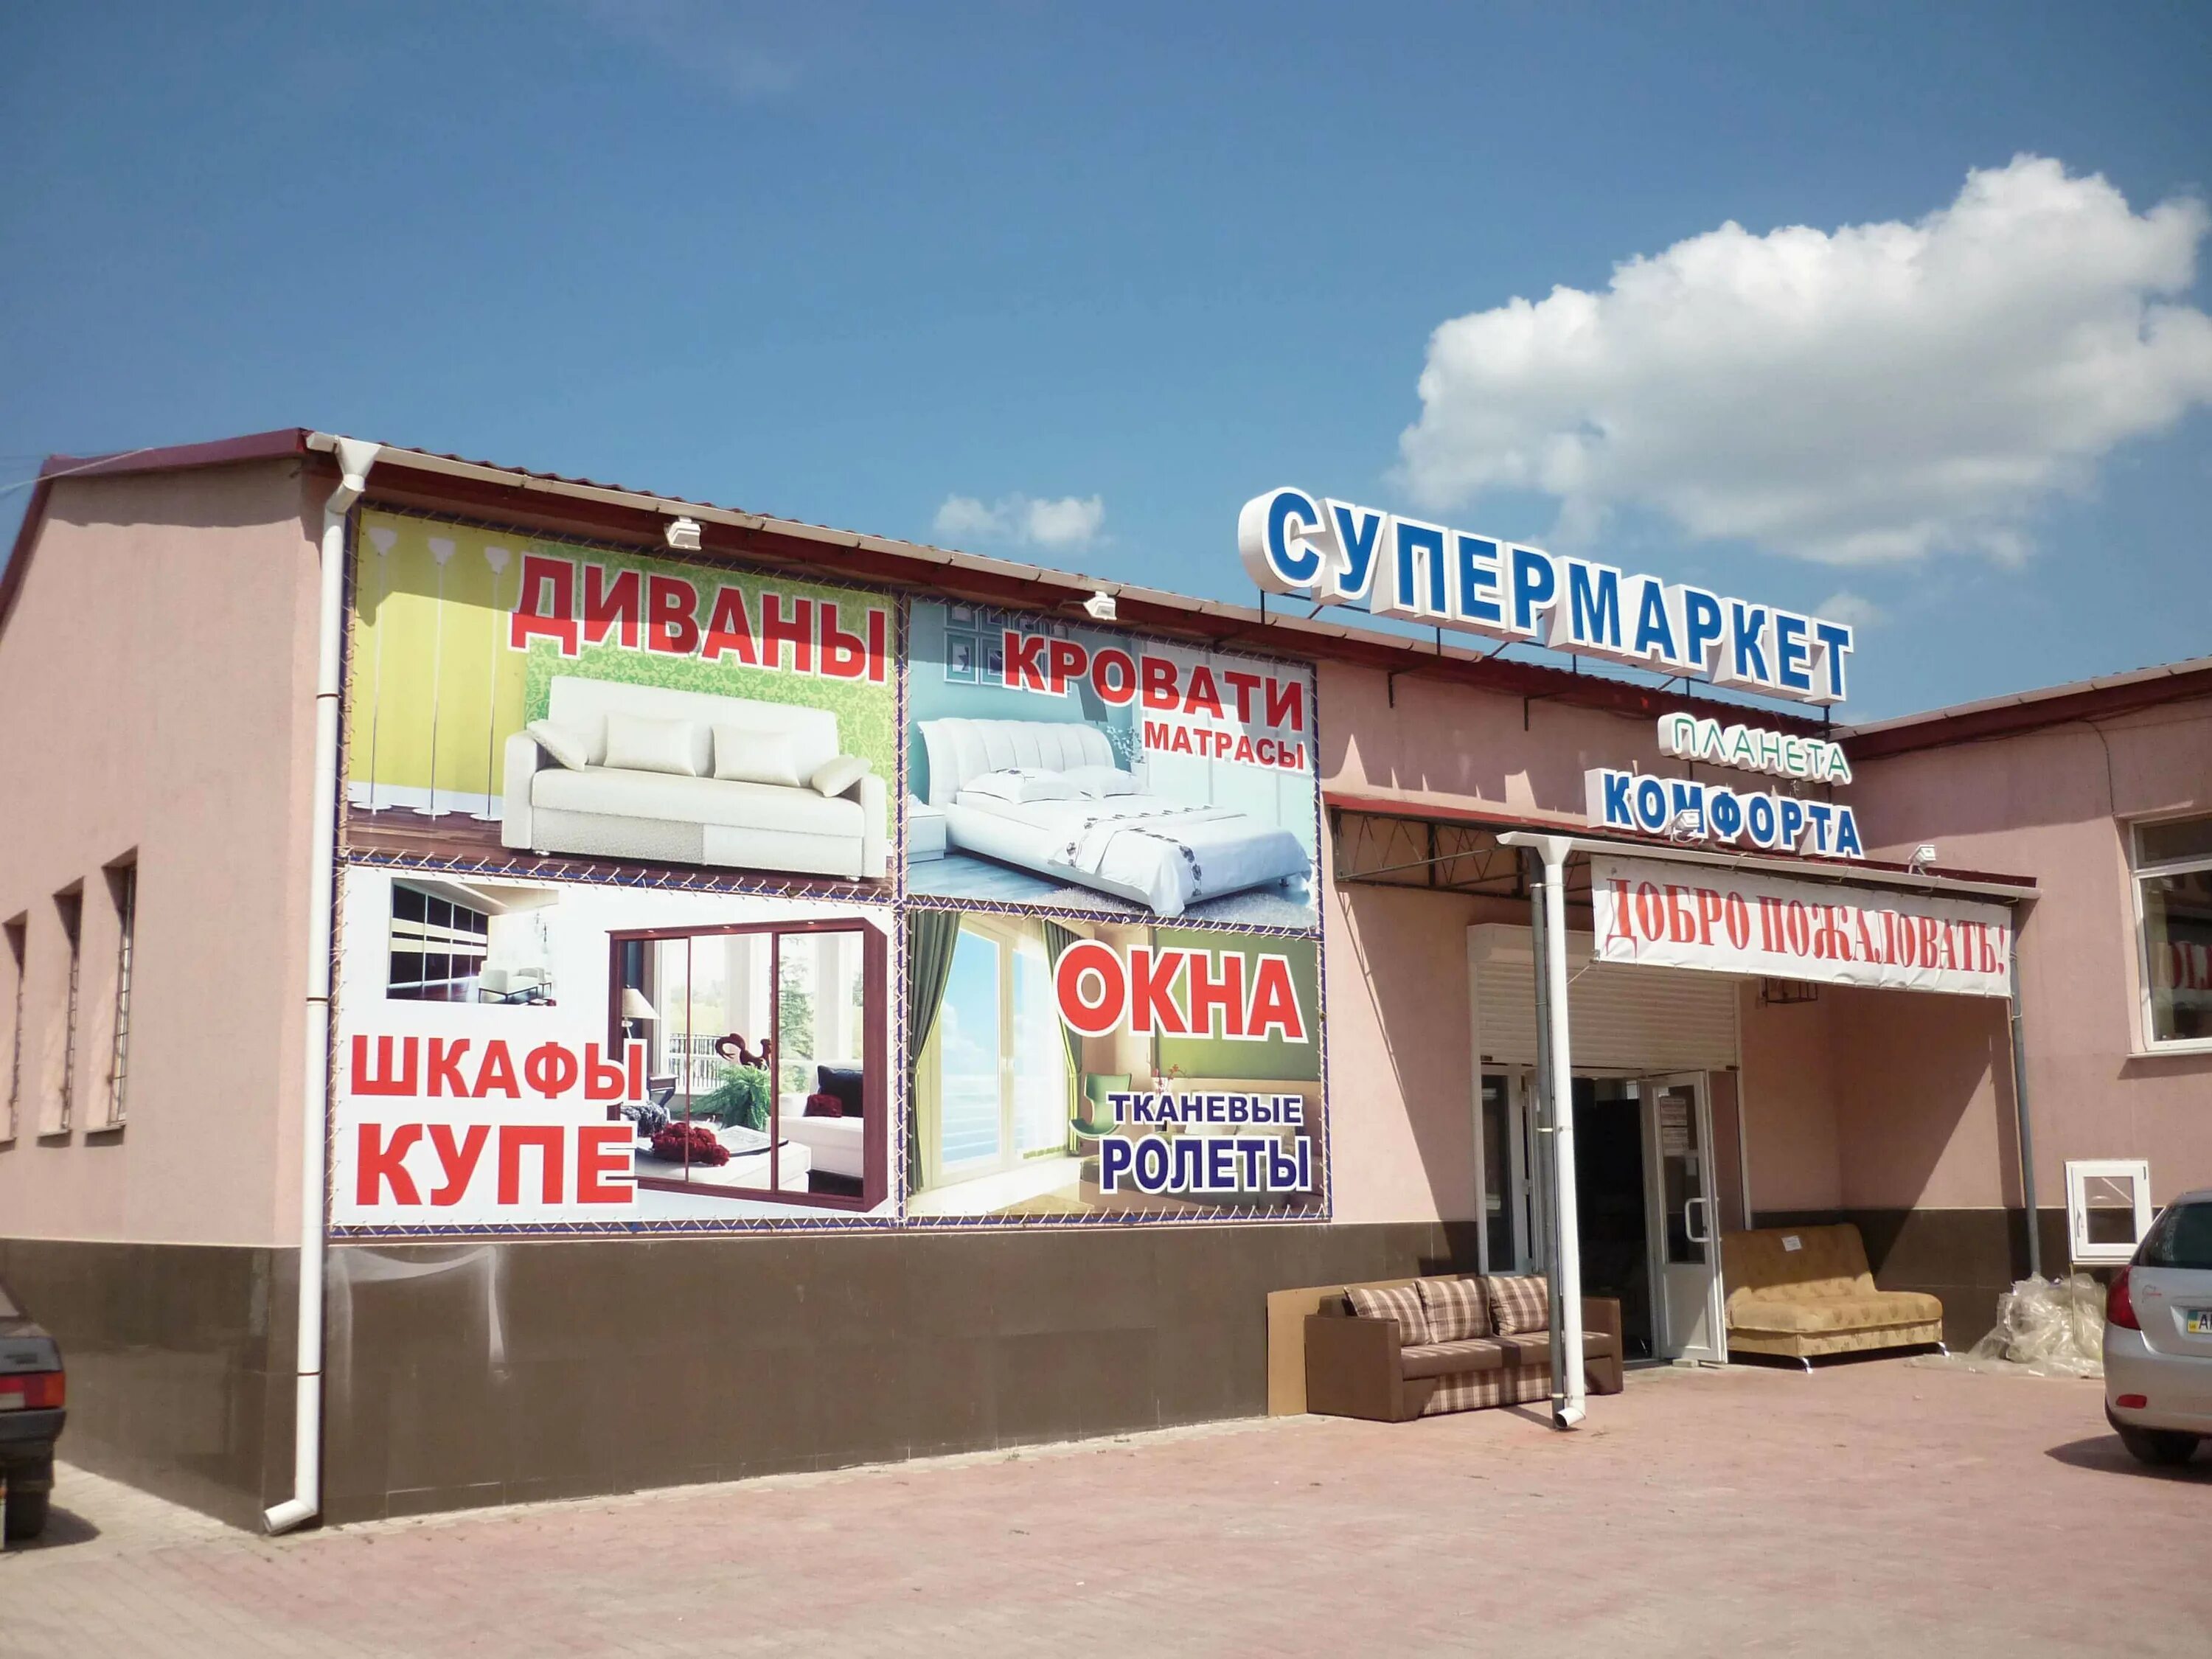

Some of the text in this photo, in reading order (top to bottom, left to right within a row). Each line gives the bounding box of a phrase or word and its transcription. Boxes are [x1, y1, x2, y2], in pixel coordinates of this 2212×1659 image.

[511, 556, 886, 682] ДИВАНЫ
[1267, 492, 1851, 699] СУПЕРМАРКЕТ
[1003, 631, 1304, 731] КРОВАТИ
[1144, 720, 1304, 771] МАТРАСЫ
[1674, 717, 1851, 783] ПЛАНЕТА
[1604, 773, 1863, 856] КОМФОРТА
[1606, 877, 2006, 975] ДОБРО ПОЖАЛОВАТЬ!
[1057, 945, 1304, 1038] ОКНА
[351, 1034, 644, 1101] ШКАФЫ
[1107, 1095, 1302, 1124] ТКАНЕВЫЕ
[356, 1123, 633, 1207] КУПЕ
[1103, 1138, 1310, 1190] РОЛЕТЫ
